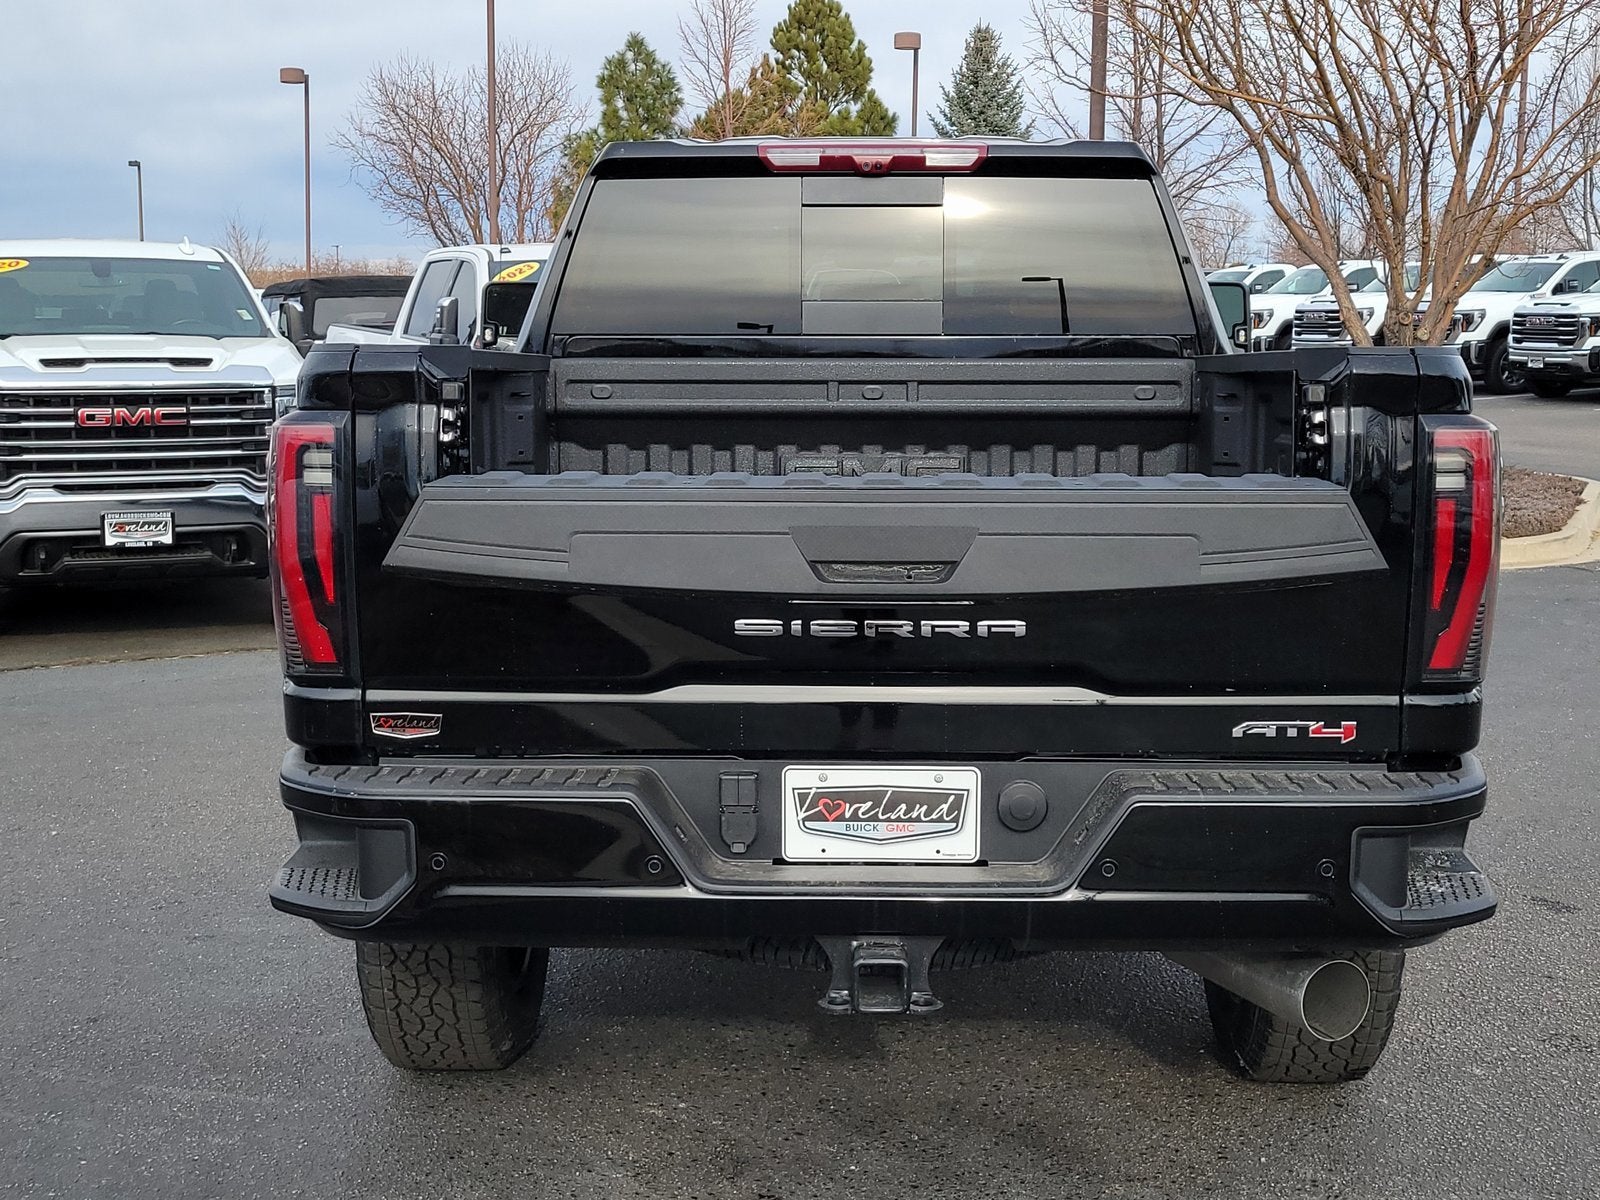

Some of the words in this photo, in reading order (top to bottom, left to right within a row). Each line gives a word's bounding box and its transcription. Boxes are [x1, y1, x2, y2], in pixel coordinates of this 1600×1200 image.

[77, 407, 187, 427] GMC
[734, 619, 1027, 638] SIERRA
[1232, 721, 1357, 744] AT4
[845, 823, 879, 832] BUICK
[886, 823, 915, 833] GMC
